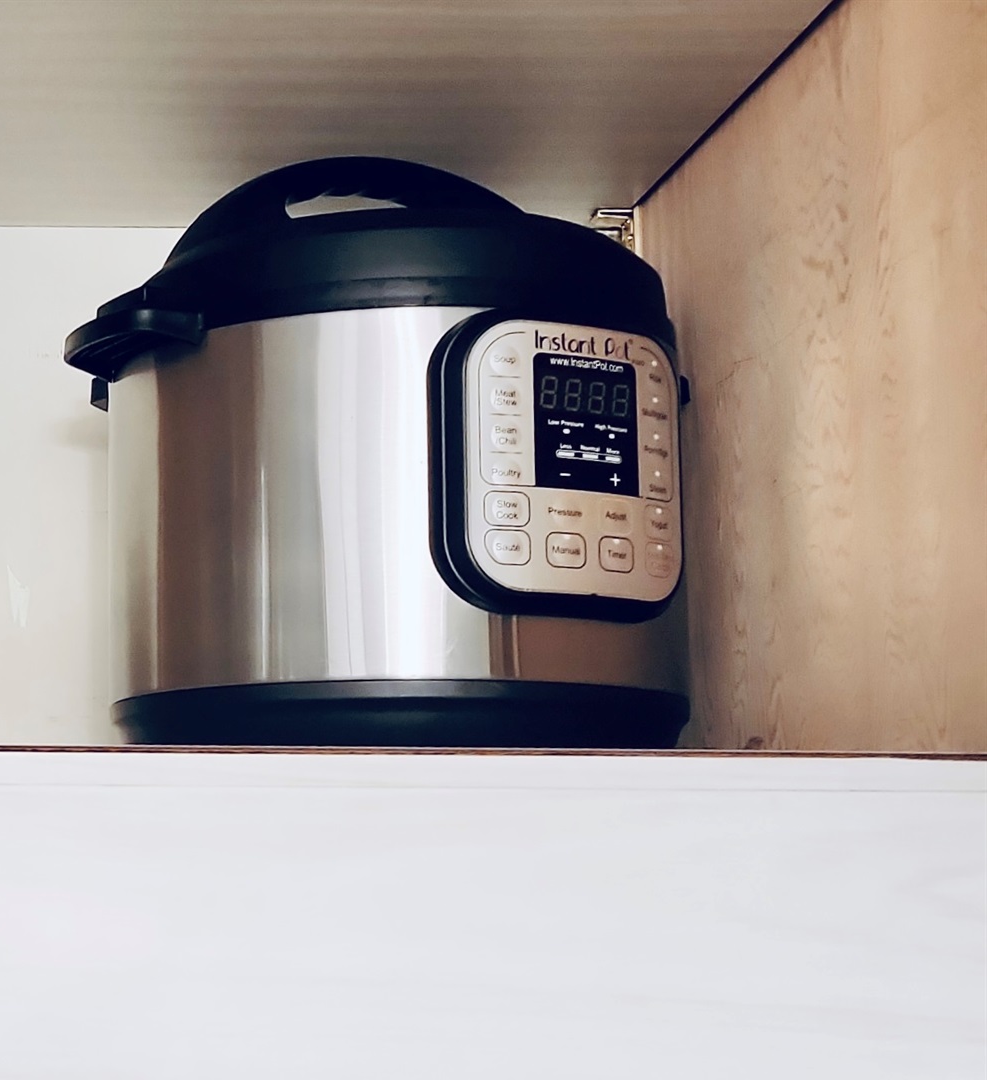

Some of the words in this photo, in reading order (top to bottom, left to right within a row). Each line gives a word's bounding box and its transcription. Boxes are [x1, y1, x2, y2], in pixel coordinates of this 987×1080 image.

[535, 330, 596, 355] Instant
[604, 338, 630, 360] Pot
[494, 425, 517, 435] Bean
[491, 468, 522, 479] Poultry
[496, 499, 518, 508] Slow
[496, 511, 519, 520] Cook
